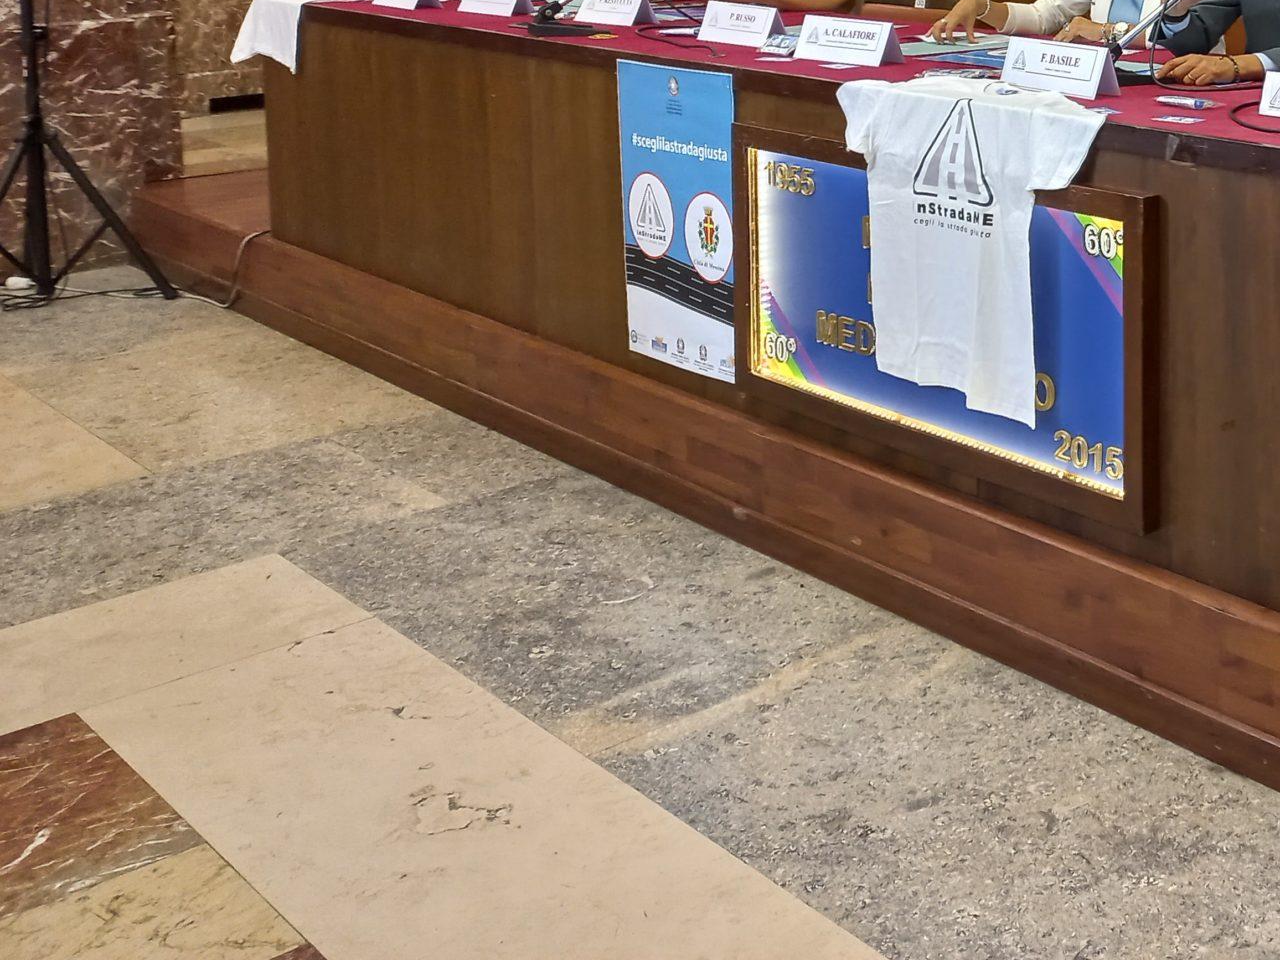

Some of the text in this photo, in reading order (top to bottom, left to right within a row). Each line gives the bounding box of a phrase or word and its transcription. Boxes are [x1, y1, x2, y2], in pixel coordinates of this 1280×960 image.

[831, 28, 877, 40] CALAFIORE
[1040, 53, 1080, 68] F. BASILE
[632, 132, 728, 162] #sceglilastradagiusta
[764, 160, 816, 196] 1955
[916, 202, 994, 226] nStradaME
[1054, 429, 1124, 481] 2015
